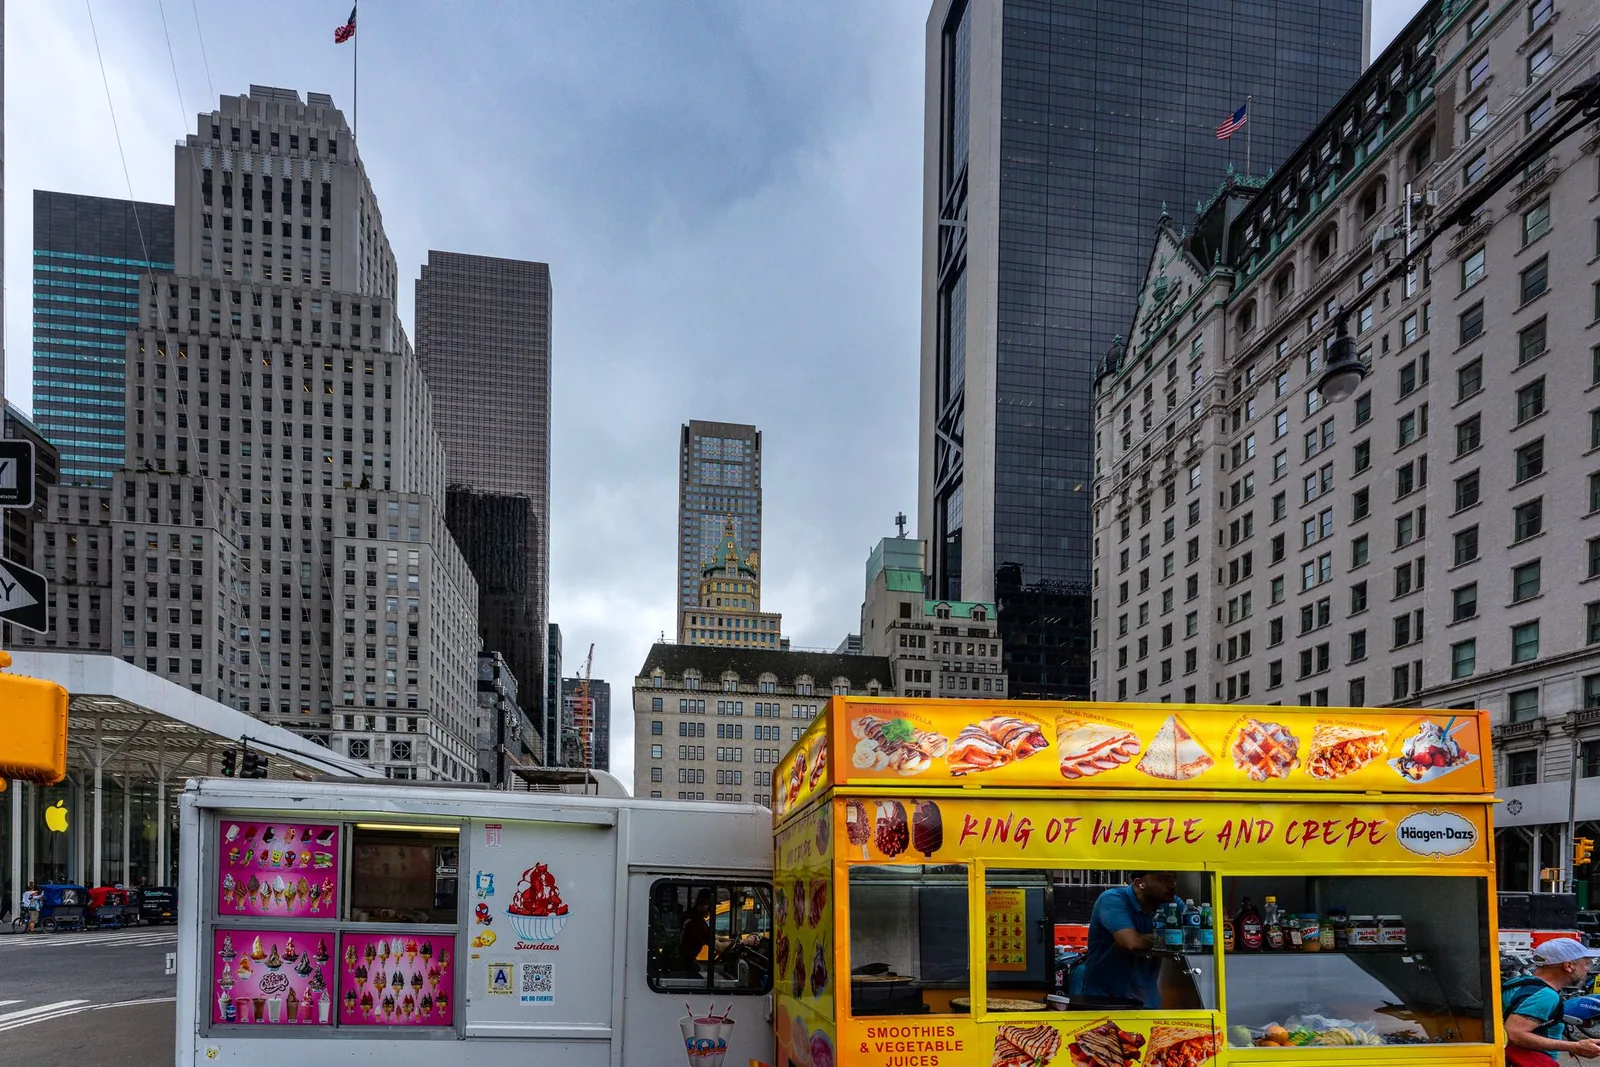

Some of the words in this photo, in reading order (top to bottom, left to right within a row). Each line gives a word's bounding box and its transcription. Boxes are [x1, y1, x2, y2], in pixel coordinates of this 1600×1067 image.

[0, 577, 17, 602] Y
[959, 811, 1035, 850] KING
[1046, 817, 1083, 845] OF
[1091, 817, 1206, 847] WAFFLE
[1216, 817, 1275, 851] AND
[1285, 817, 1389, 850] CREPE
[514, 940, 560, 951] Sundaes
[494, 969, 508, 984] A
[1171, 1020, 1194, 1028] CHICKEN
[867, 1026, 955, 1038] SMOOTHIES
[860, 1042, 869, 1053] &
[875, 1040, 963, 1053] VEGETABLE
[885, 1055, 939, 1067] JUICES
